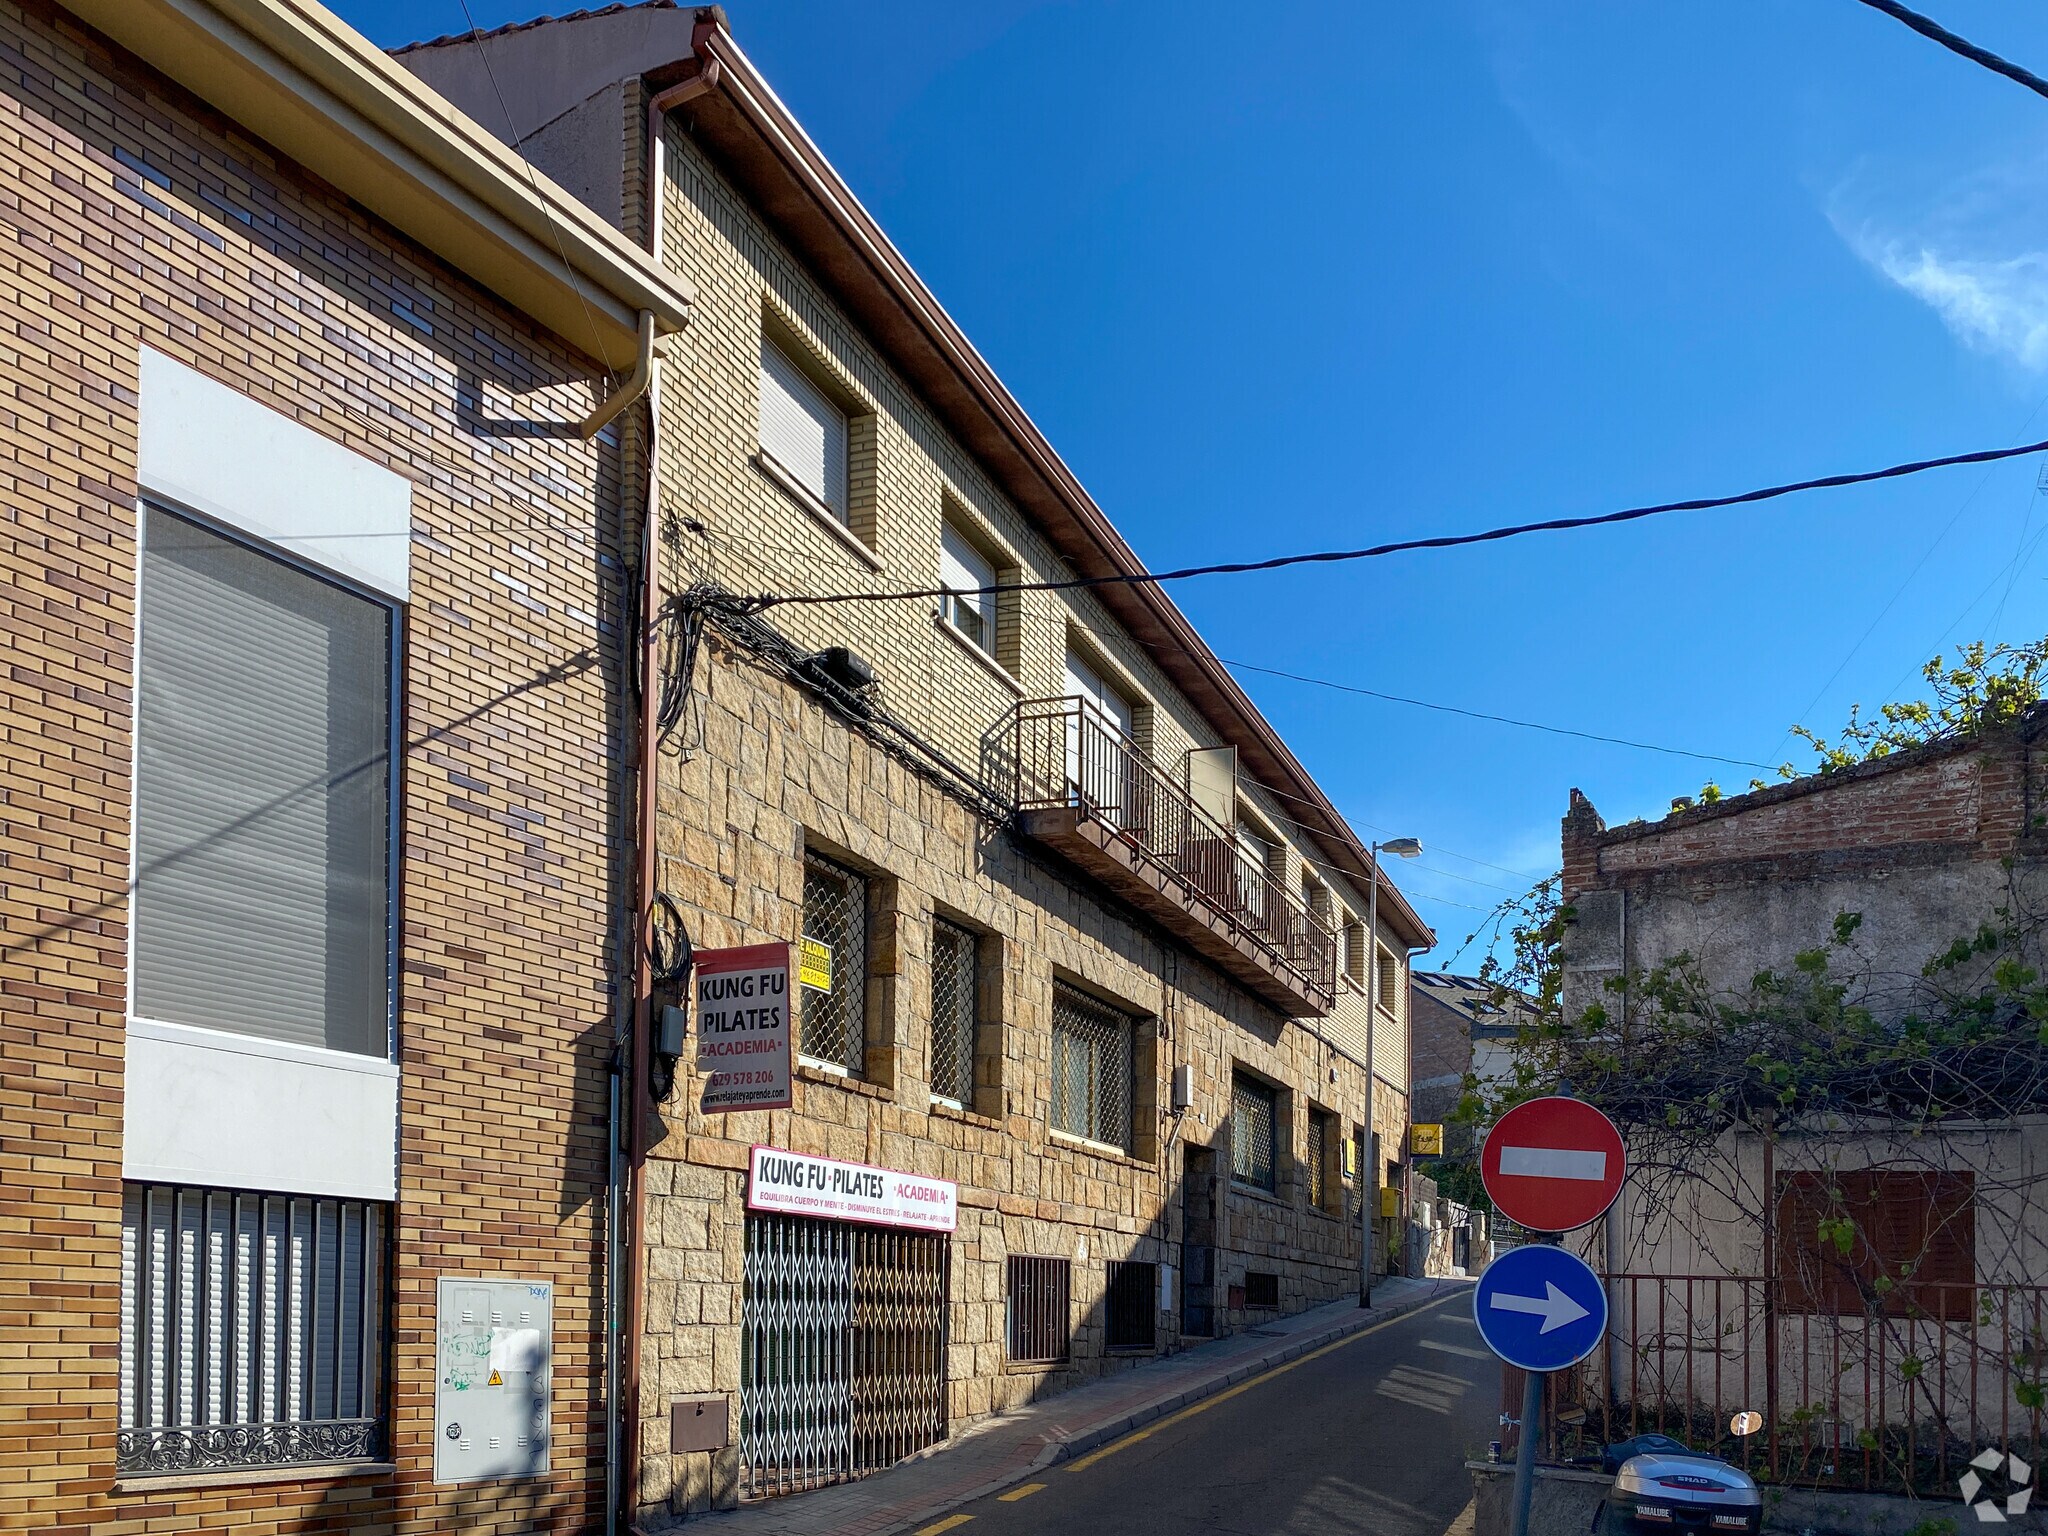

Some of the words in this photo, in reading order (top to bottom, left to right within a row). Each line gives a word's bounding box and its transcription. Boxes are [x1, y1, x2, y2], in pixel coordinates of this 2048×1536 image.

[806, 940, 829, 960] ALQUILA
[699, 975, 754, 1002] KUNG
[759, 973, 785, 996] FU
[704, 1006, 780, 1033] PILATES
[712, 1073, 731, 1087] 629
[733, 1072, 753, 1085] 578
[755, 1070, 774, 1084] 206
[704, 1088, 785, 1104] www.relajateyaprende.com
[759, 1155, 804, 1188] KUNG
[807, 1163, 827, 1190] FU
[832, 1167, 884, 1200] PILATES
[760, 1191, 793, 1204] EQUILIBRA
[794, 1196, 819, 1207] CUERPO
[819, 1199, 824, 1207] Y
[824, 1200, 844, 1209] MENTE
[847, 1202, 876, 1214] DISMINUYE
[876, 1207, 882, 1215] EL
[902, 1210, 927, 1221] RELAJATE
[1677, 1476, 1708, 1484] SHAD
[1636, 1505, 1670, 1518] YAMALUBE
[1714, 1514, 1748, 1526] YAMALUBE
